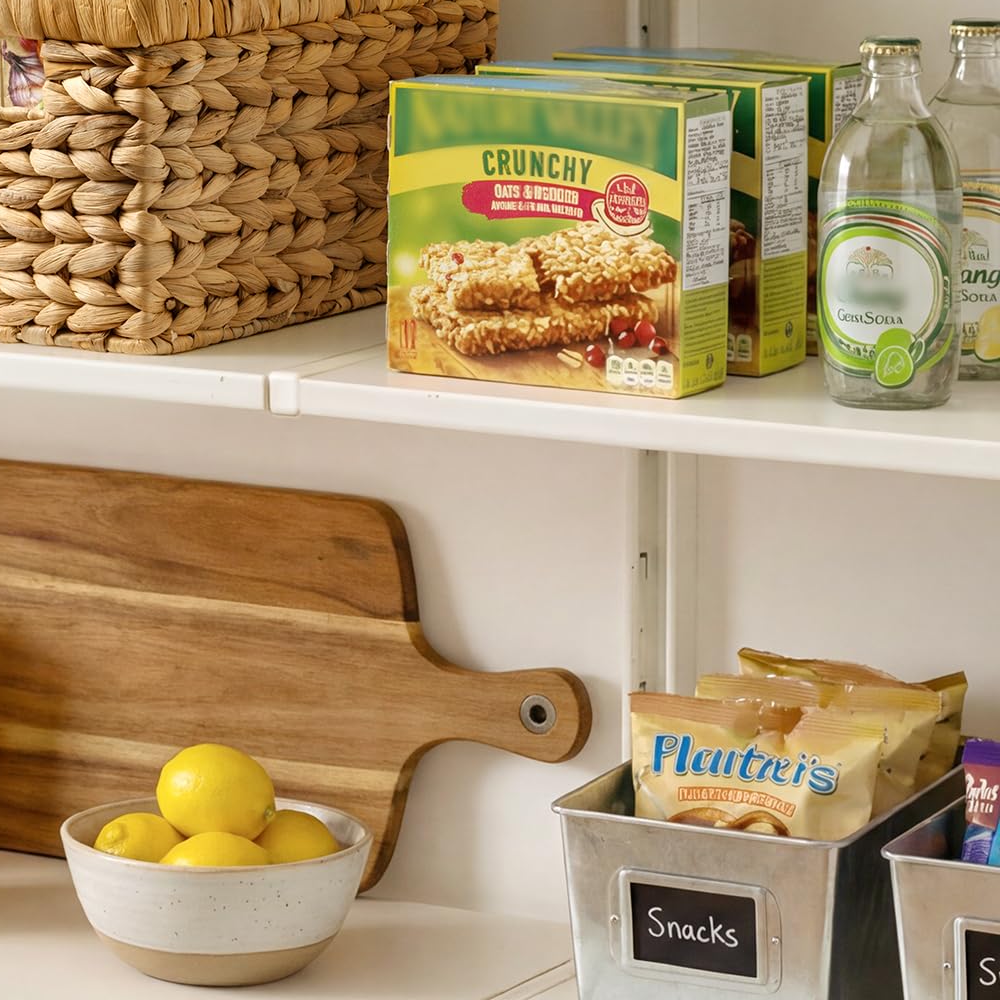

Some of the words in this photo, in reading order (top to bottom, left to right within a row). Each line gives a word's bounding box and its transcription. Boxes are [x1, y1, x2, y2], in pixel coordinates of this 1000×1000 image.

[482, 149, 593, 185] CRUNCHY
[494, 183, 521, 199] OATS
[647, 906, 739, 948] Snacks
[979, 957, 1000, 986] S
